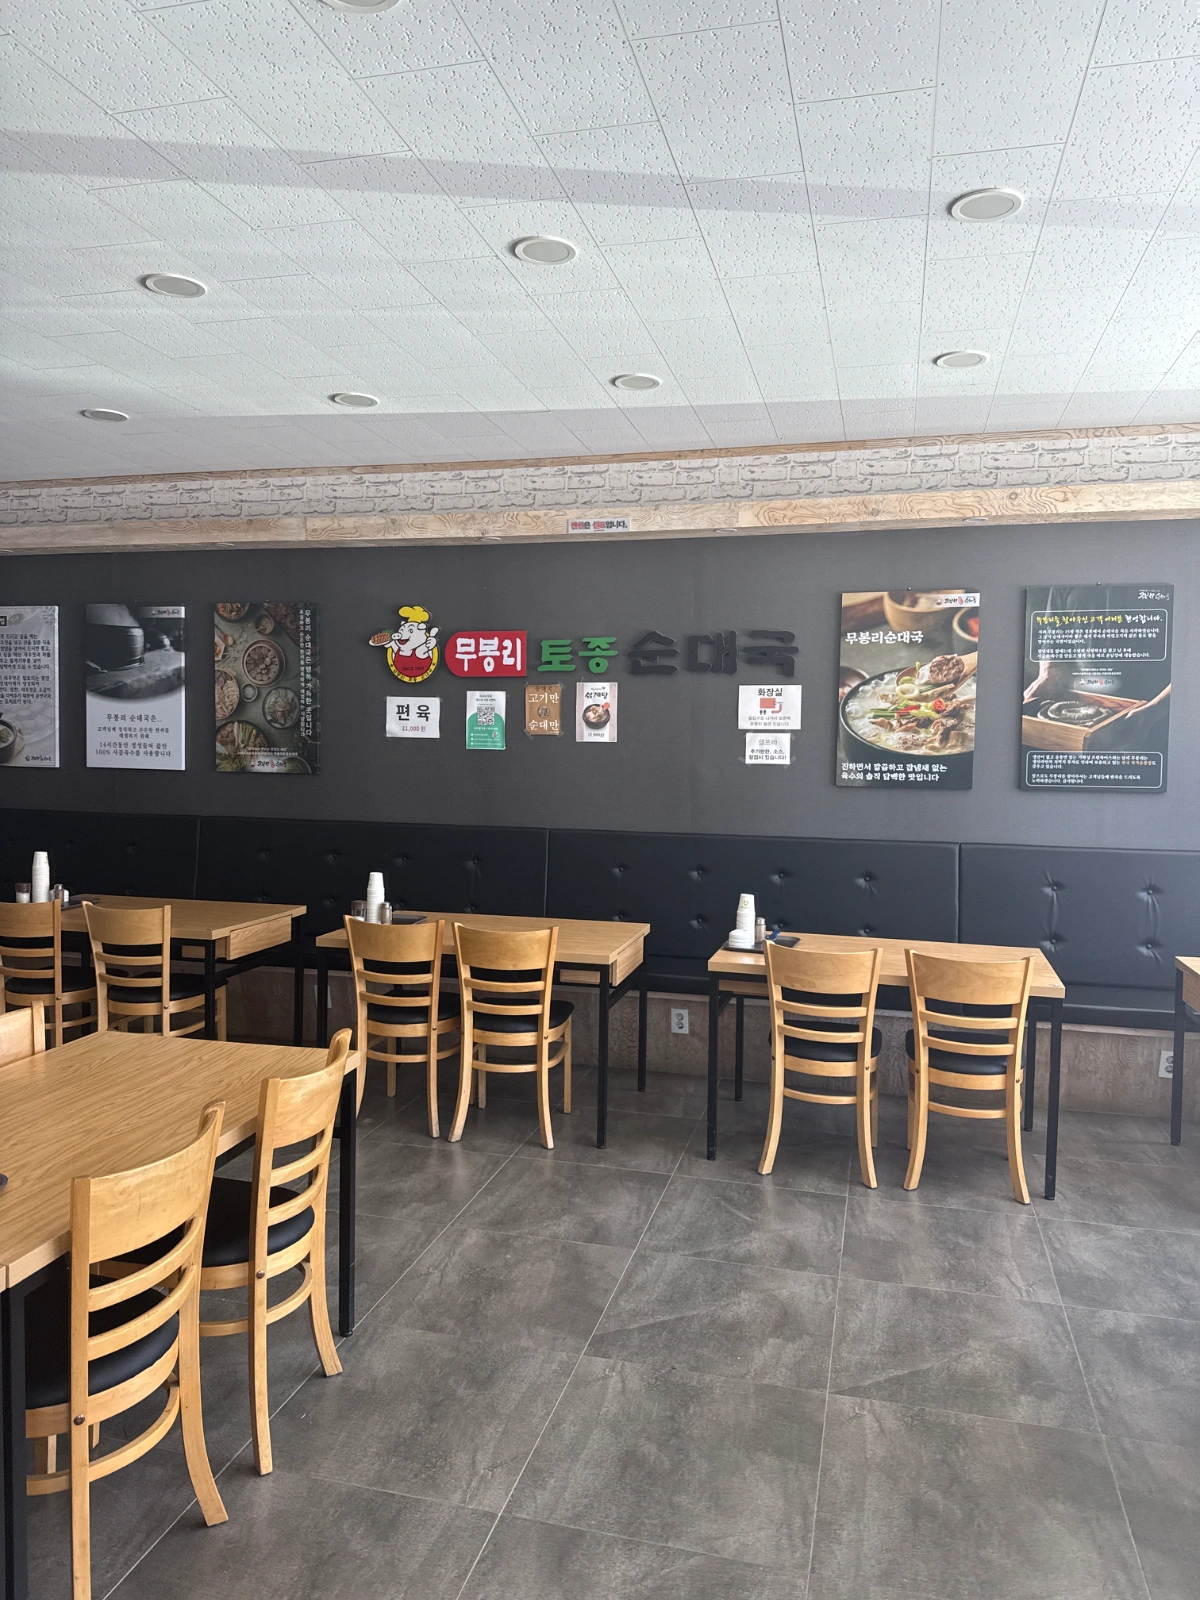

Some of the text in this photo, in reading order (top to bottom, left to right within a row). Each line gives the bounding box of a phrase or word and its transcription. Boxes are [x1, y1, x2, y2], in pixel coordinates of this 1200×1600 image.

[1090, 615, 1103, 624] 고객
[845, 631, 924, 645] 무봉리순대국
[455, 630, 799, 678] 무봉리 토종 순대국
[758, 688, 783, 697] 화장실
[528, 692, 559, 704] 고기만
[106, 714, 126, 722] 무봉리
[529, 720, 559, 731] 순대만
[874, 763, 904, 771] 깔끔하고
[906, 764, 930, 772] 잡냄새
[932, 764, 948, 772] 없는
[841, 772, 863, 780] 육수의
[883, 772, 906, 781] 담백한
[908, 773, 939, 782] 맛입니다
